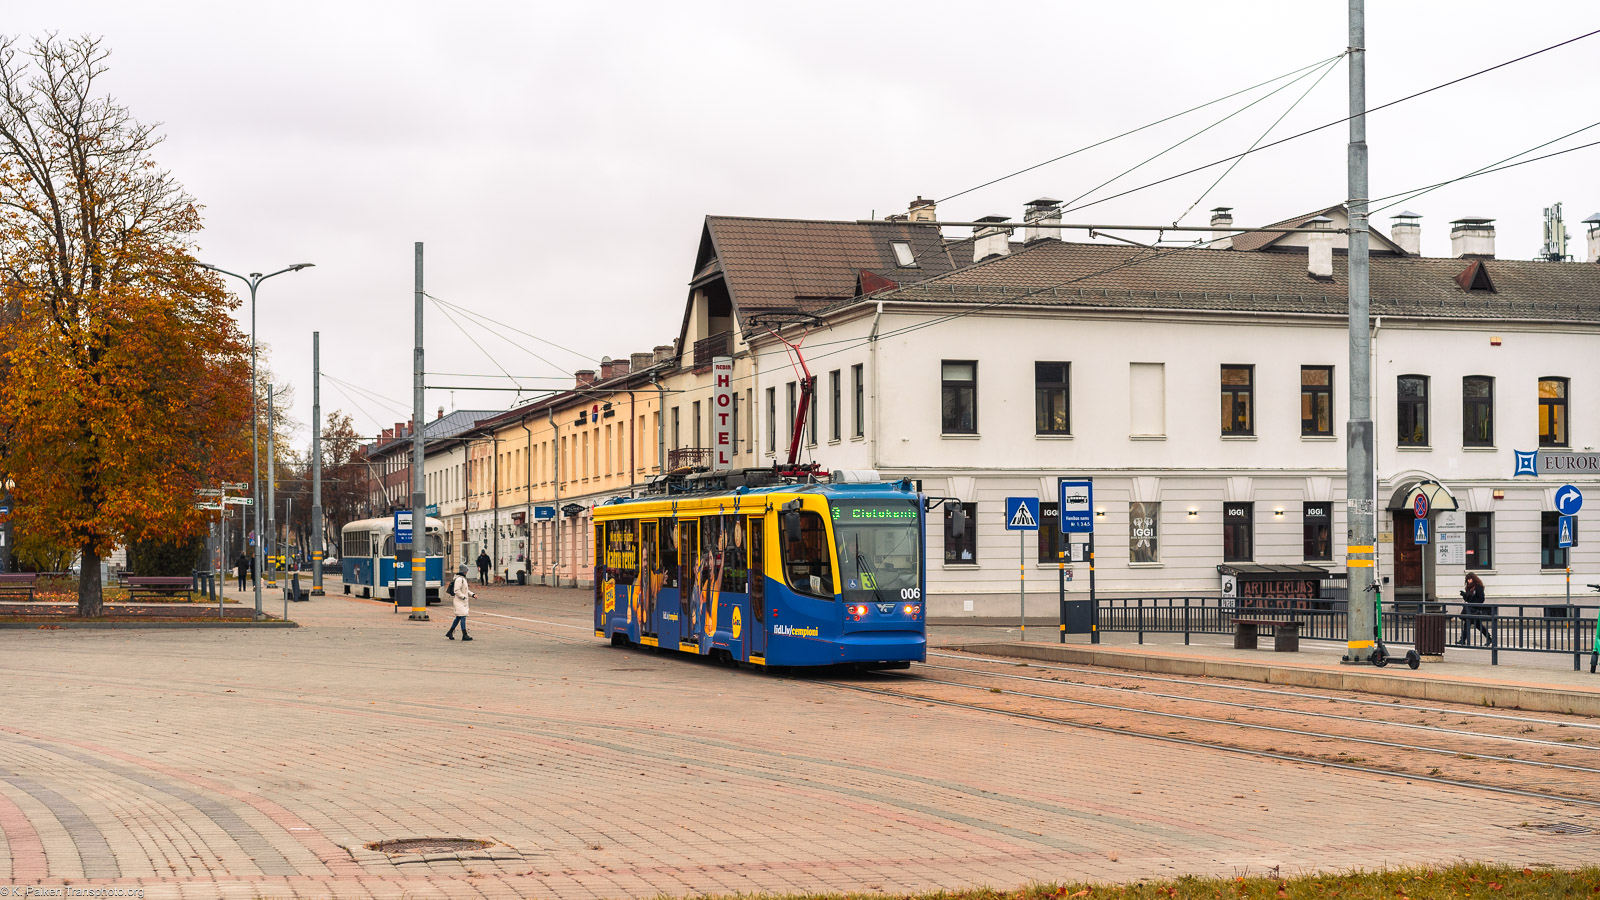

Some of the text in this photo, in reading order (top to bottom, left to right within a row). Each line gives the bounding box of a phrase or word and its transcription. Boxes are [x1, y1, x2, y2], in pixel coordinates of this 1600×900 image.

[717, 374, 730, 464] HOTEL
[1545, 456, 1600, 469] EUROR
[1133, 528, 1153, 536] IGGI
[900, 588, 921, 600] 006
